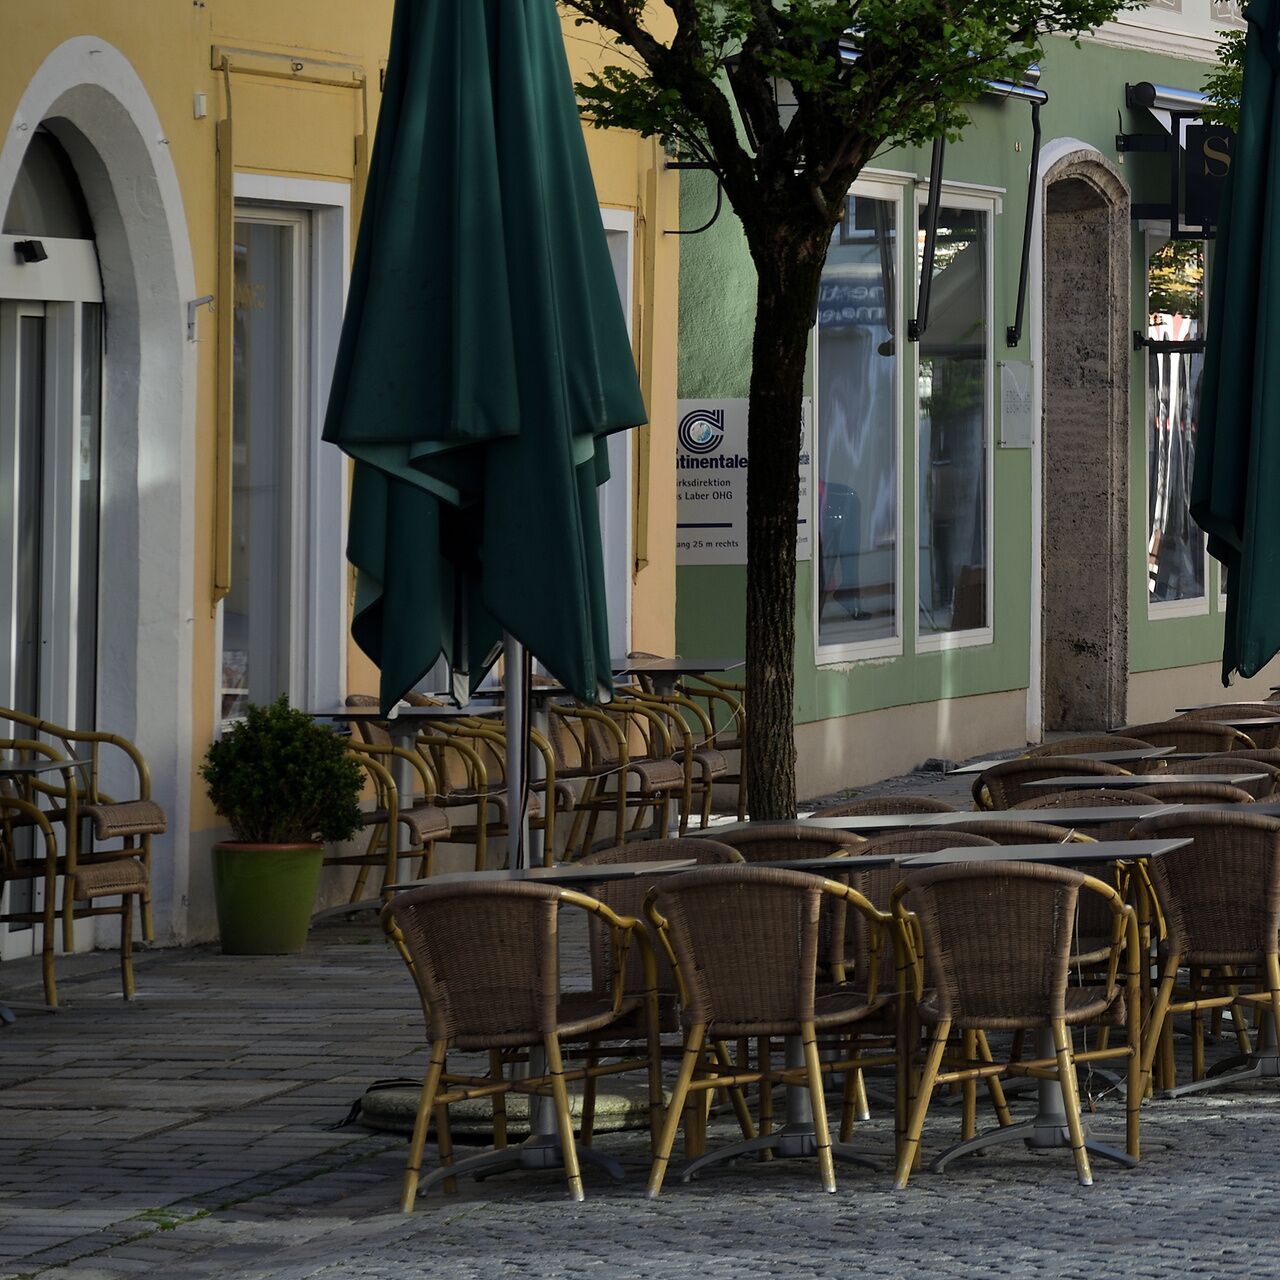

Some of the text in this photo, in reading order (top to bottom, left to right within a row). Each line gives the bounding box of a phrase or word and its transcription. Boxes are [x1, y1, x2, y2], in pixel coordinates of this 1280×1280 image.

[1203, 136, 1232, 176] S
[685, 491, 710, 500] Laber
[712, 491, 733, 500] OHG
[715, 540, 739, 548] rechts
